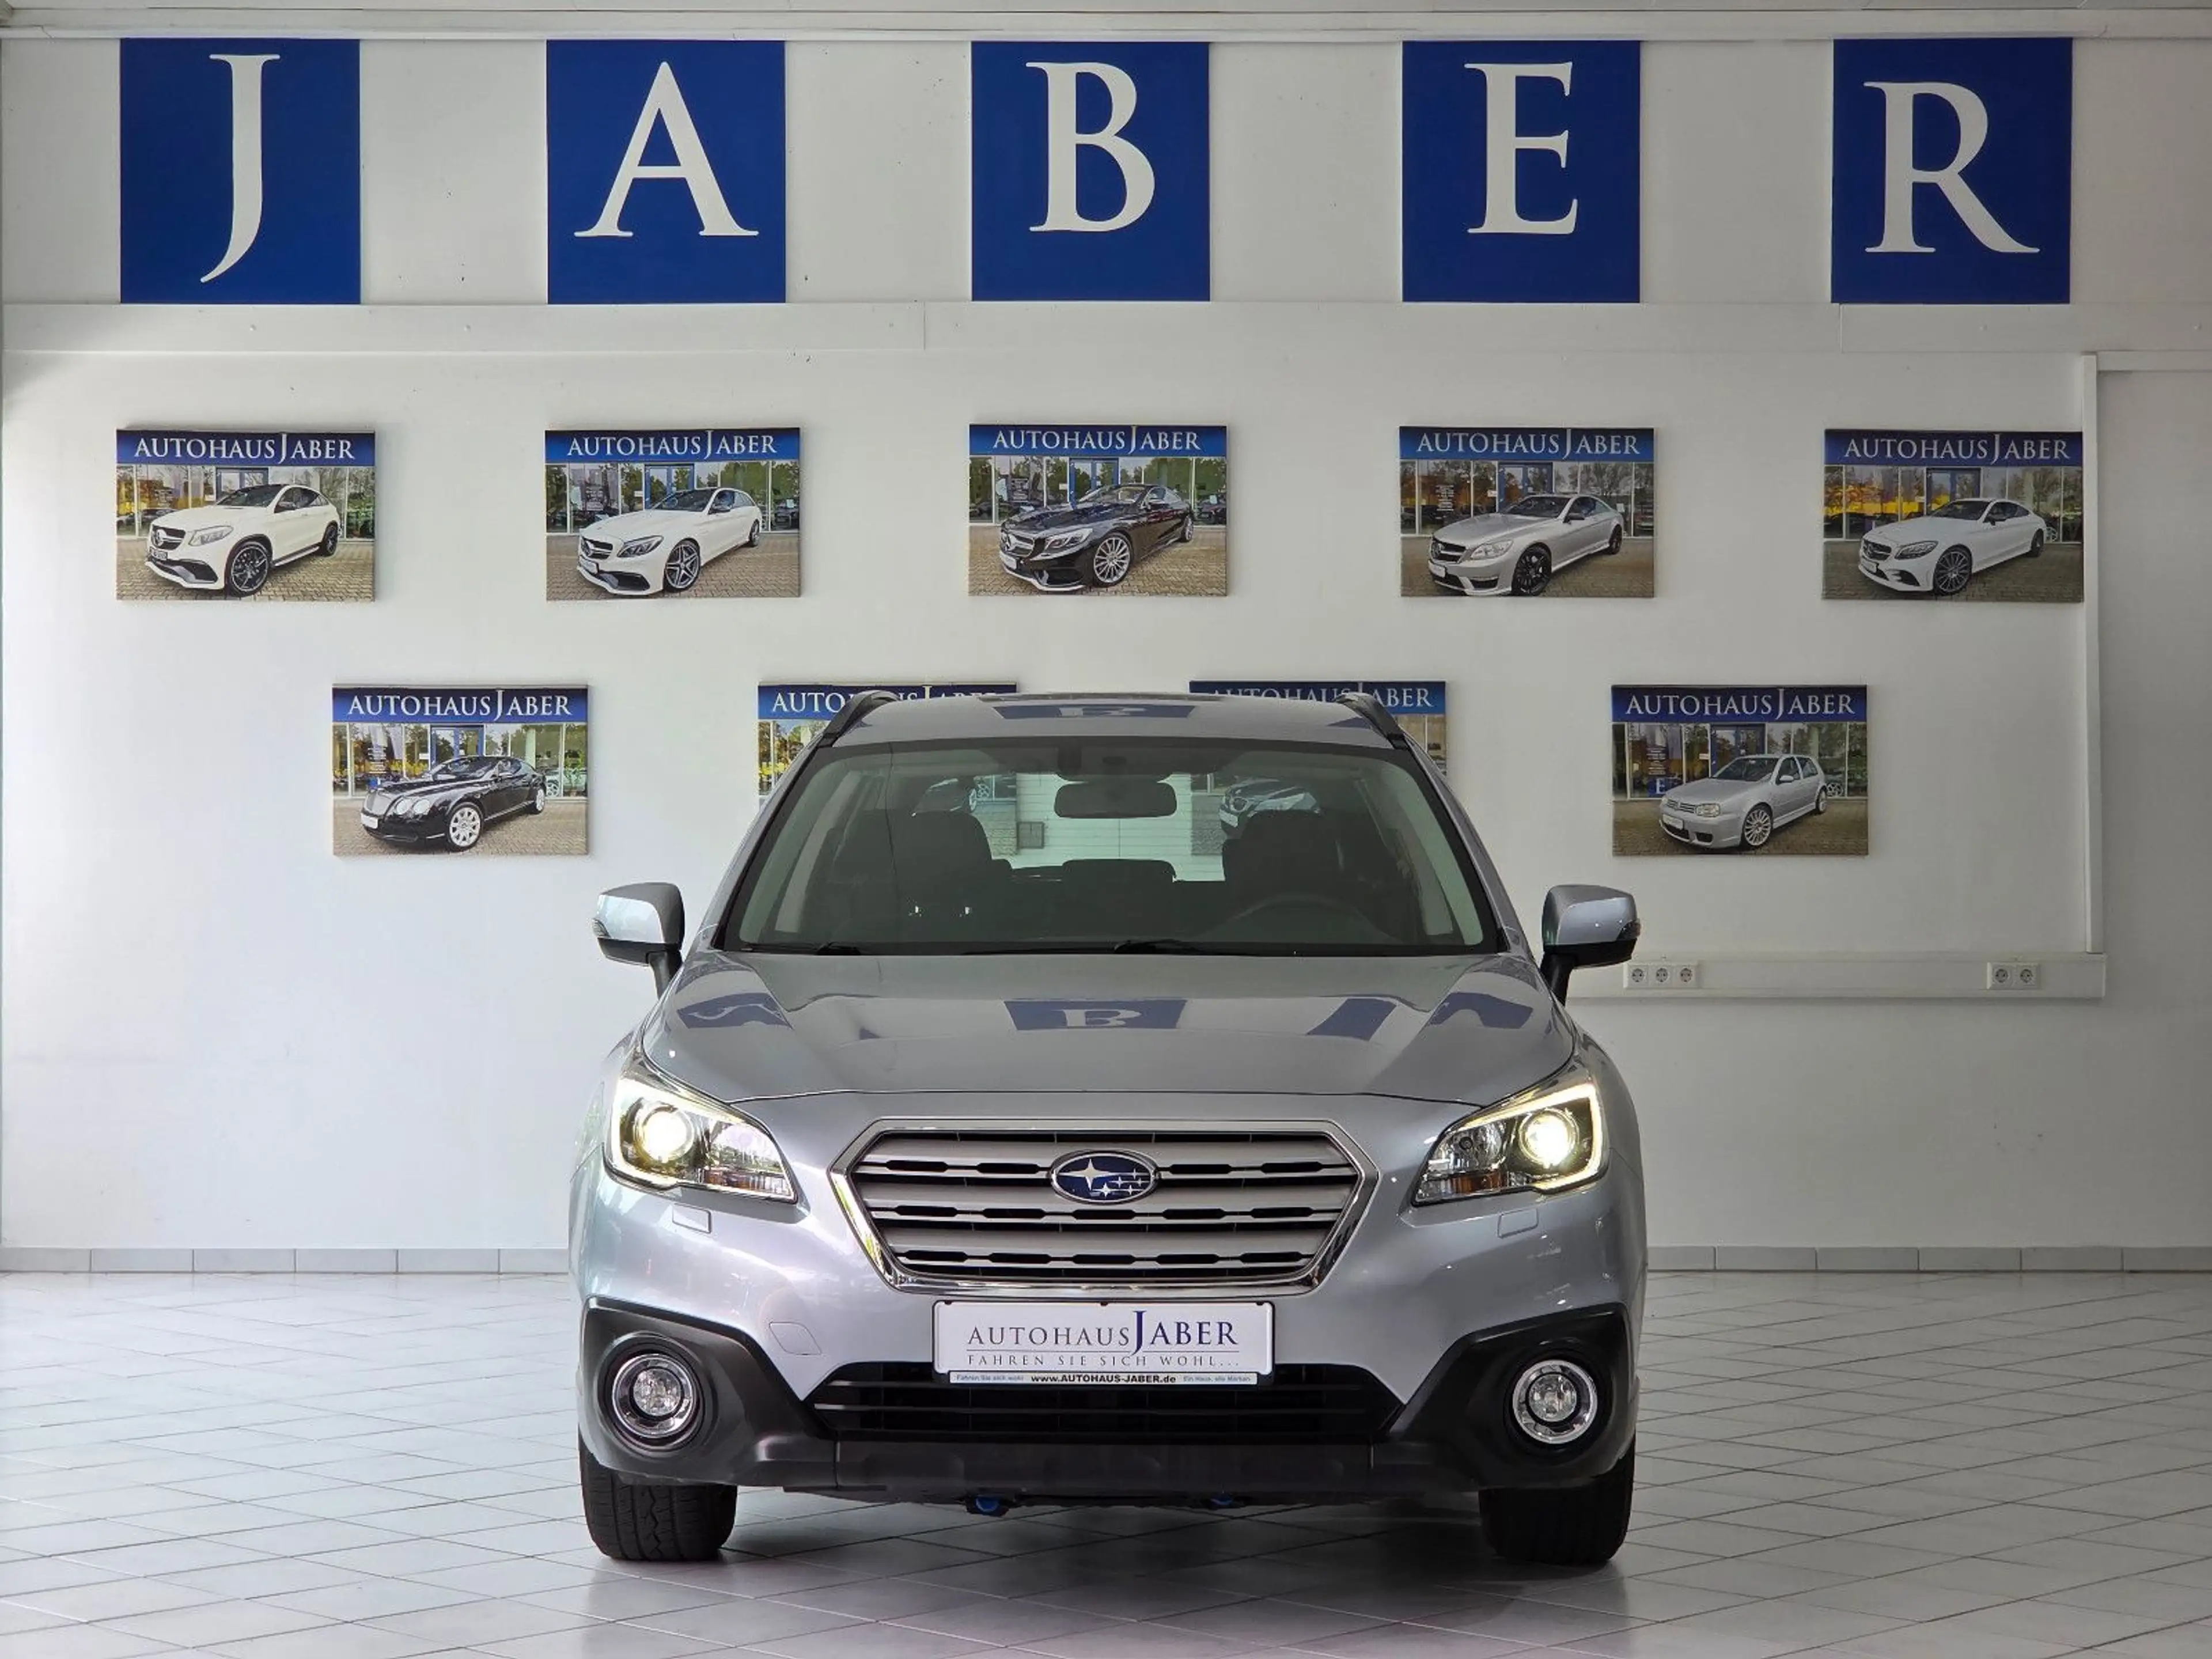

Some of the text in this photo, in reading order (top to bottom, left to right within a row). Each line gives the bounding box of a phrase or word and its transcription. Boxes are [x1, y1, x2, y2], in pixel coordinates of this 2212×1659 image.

[968, 1355, 1044, 1366] FAHREN
[1058, 1355, 1087, 1366] SIE
[1100, 1355, 1146, 1367] SICH
[1031, 1374, 1176, 1383] www.AUTOHAUS-JABER.de
